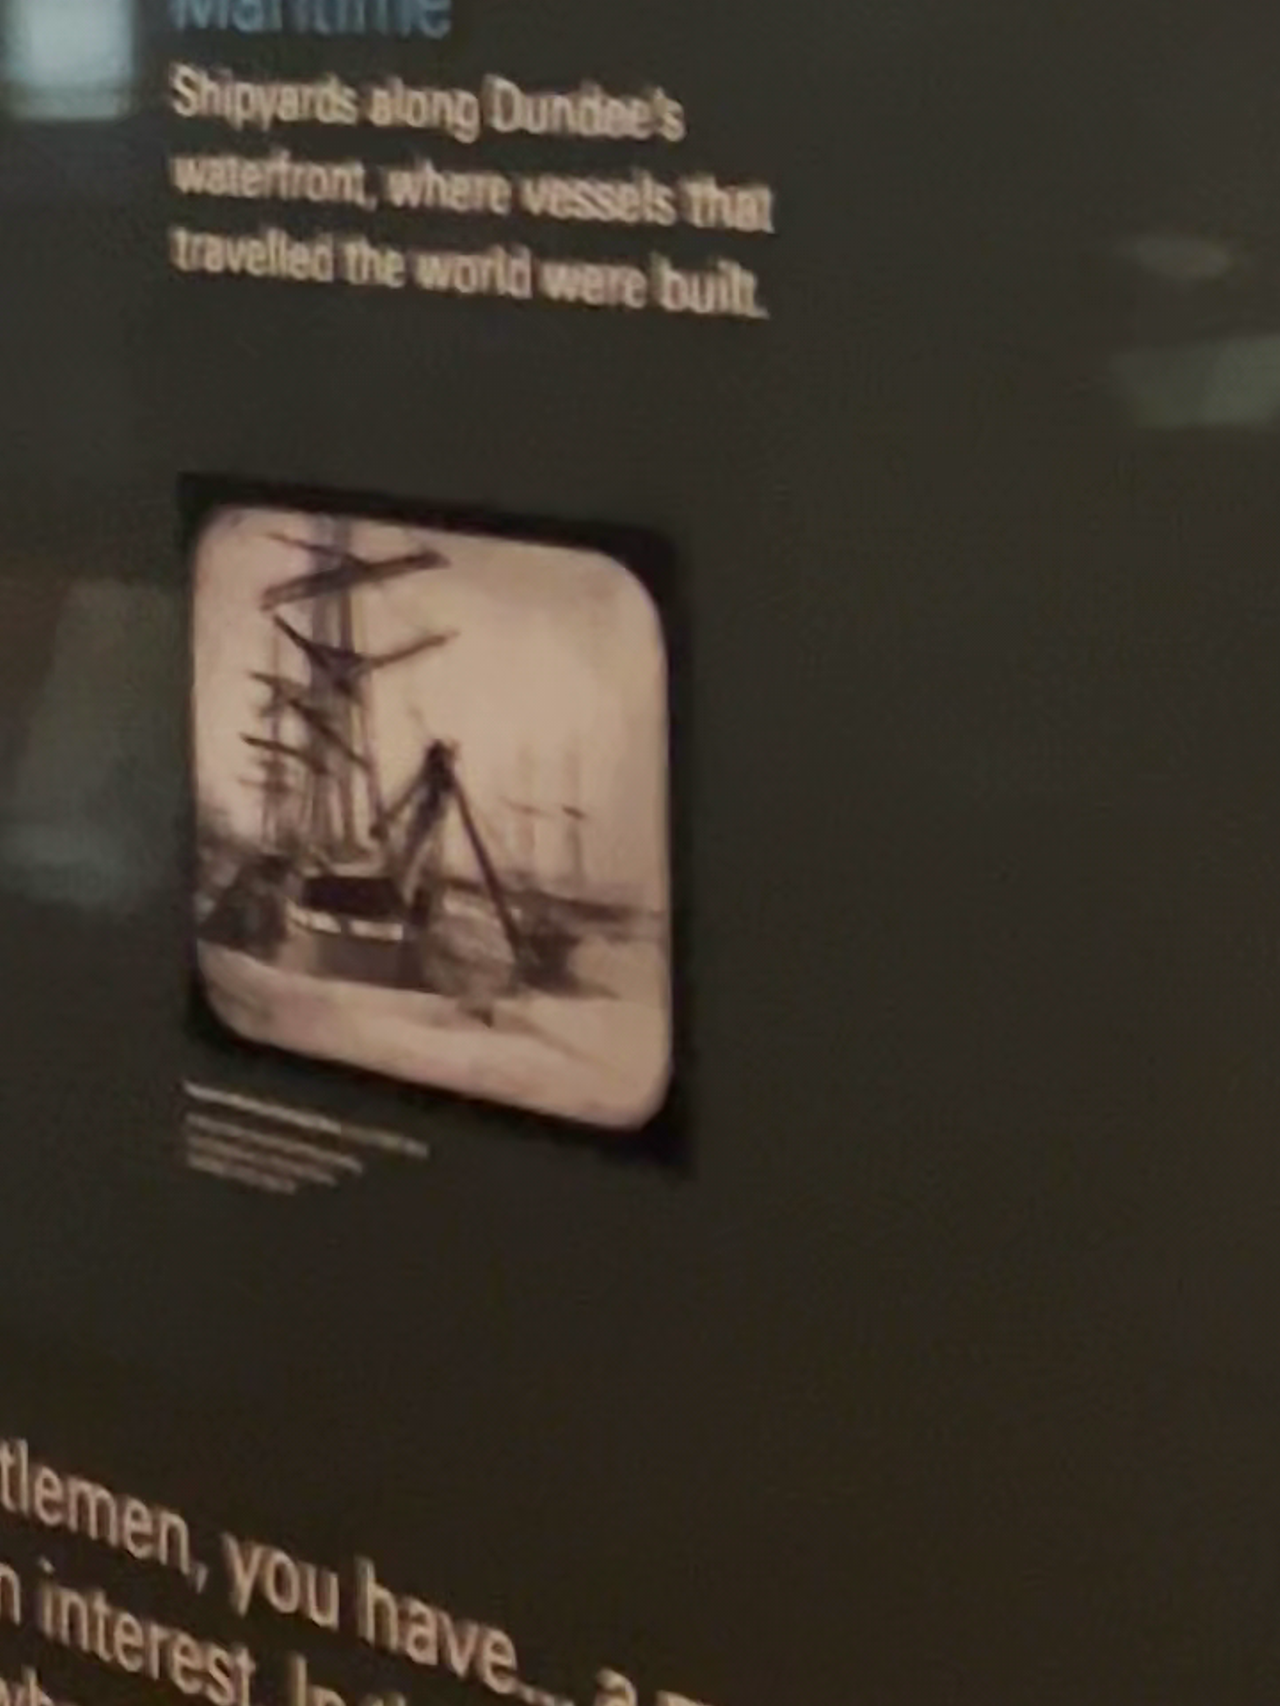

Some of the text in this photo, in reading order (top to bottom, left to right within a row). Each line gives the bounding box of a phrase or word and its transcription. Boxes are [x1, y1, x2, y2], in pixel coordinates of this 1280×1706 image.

[172, 63, 686, 143] Shipyards along Dundee's
[171, 149, 775, 234] waterfront, where vessels that
[172, 227, 770, 319] travelled the world were built.
[225, 1531, 339, 1630] you
